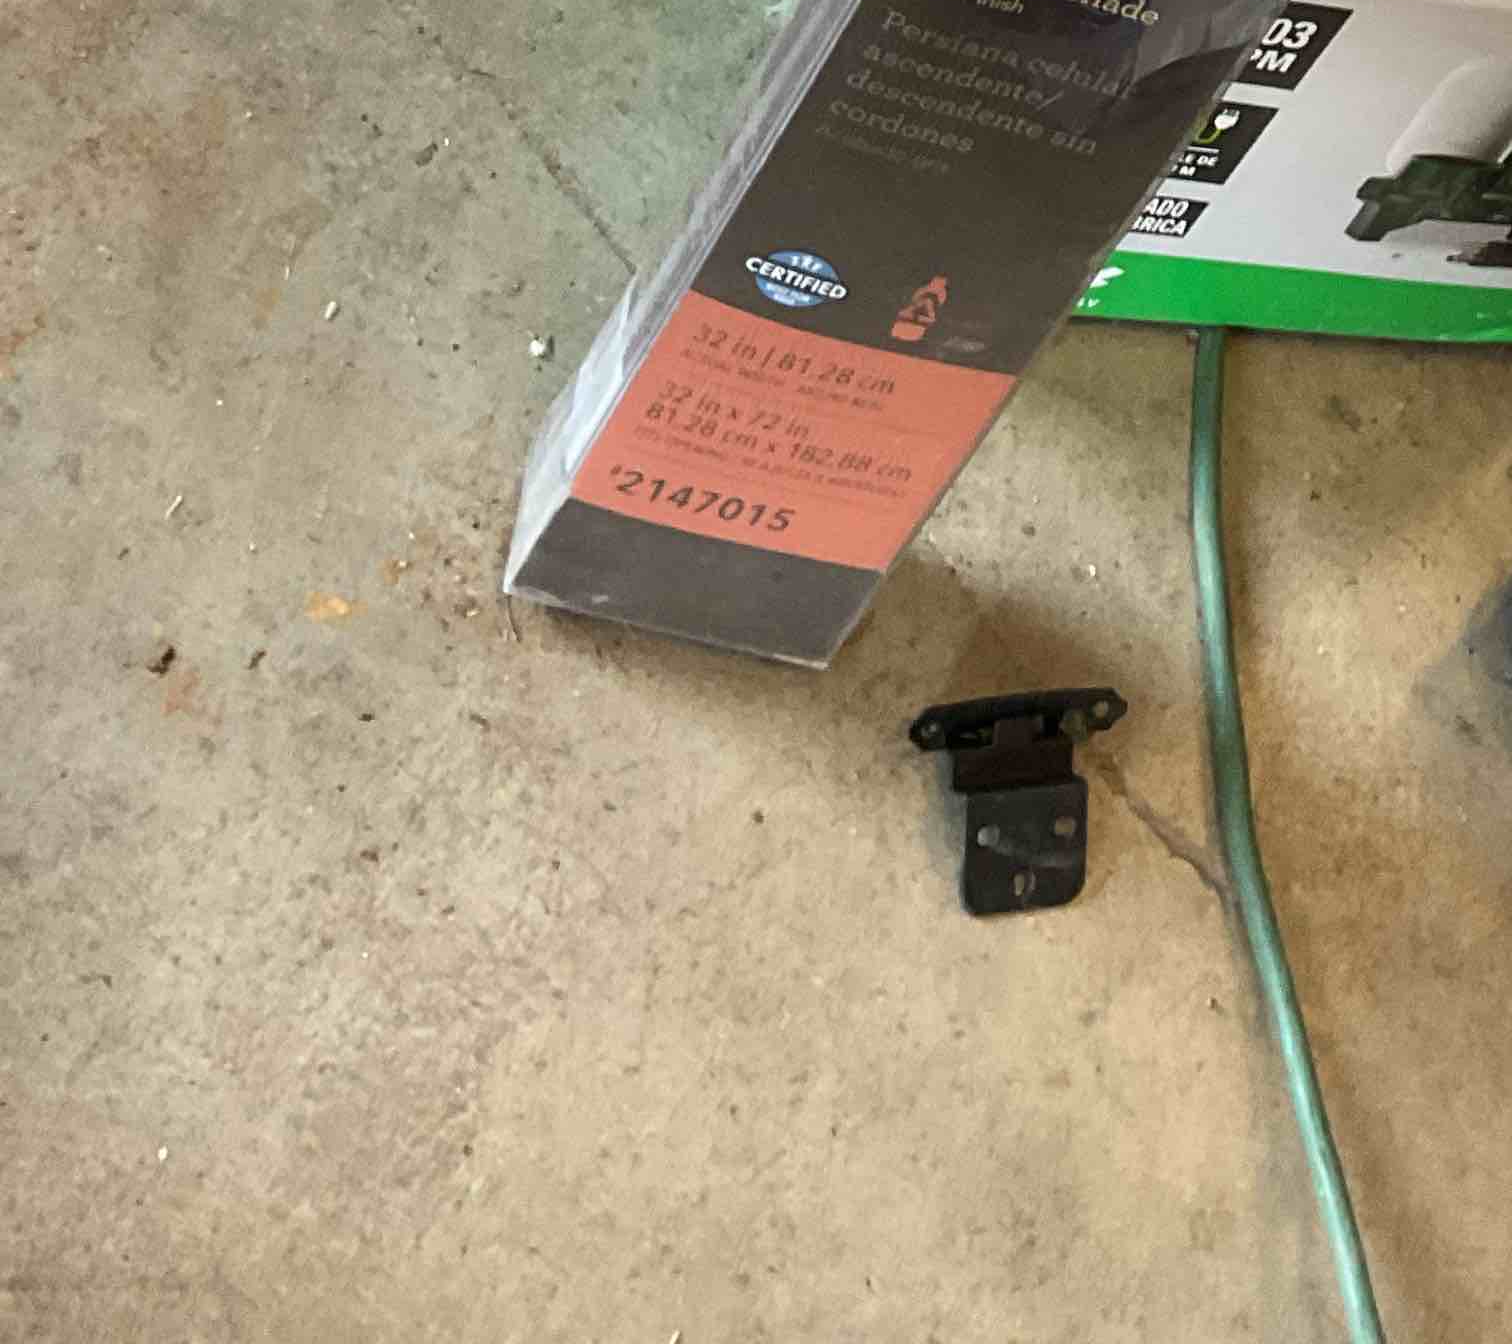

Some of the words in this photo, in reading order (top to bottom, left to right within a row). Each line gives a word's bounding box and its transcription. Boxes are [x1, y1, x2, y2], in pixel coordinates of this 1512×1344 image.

[880, 8, 1021, 66] Persiana
[1026, 56, 1133, 101] celular
[1260, 17, 1319, 50] 03
[830, 97, 976, 153] cordones
[845, 68, 1045, 140] descendente
[1049, 132, 1098, 157] sin
[745, 256, 848, 301] CERTIFIED
[693, 322, 728, 350] 32
[731, 334, 757, 361] in
[777, 351, 856, 387] 81.28
[857, 372, 896, 396] cm
[659, 380, 692, 405] 32
[698, 391, 721, 416] in
[748, 409, 778, 431] 72
[785, 415, 810, 441] in
[721, 429, 758, 451] cm
[874, 462, 913, 483] cm
